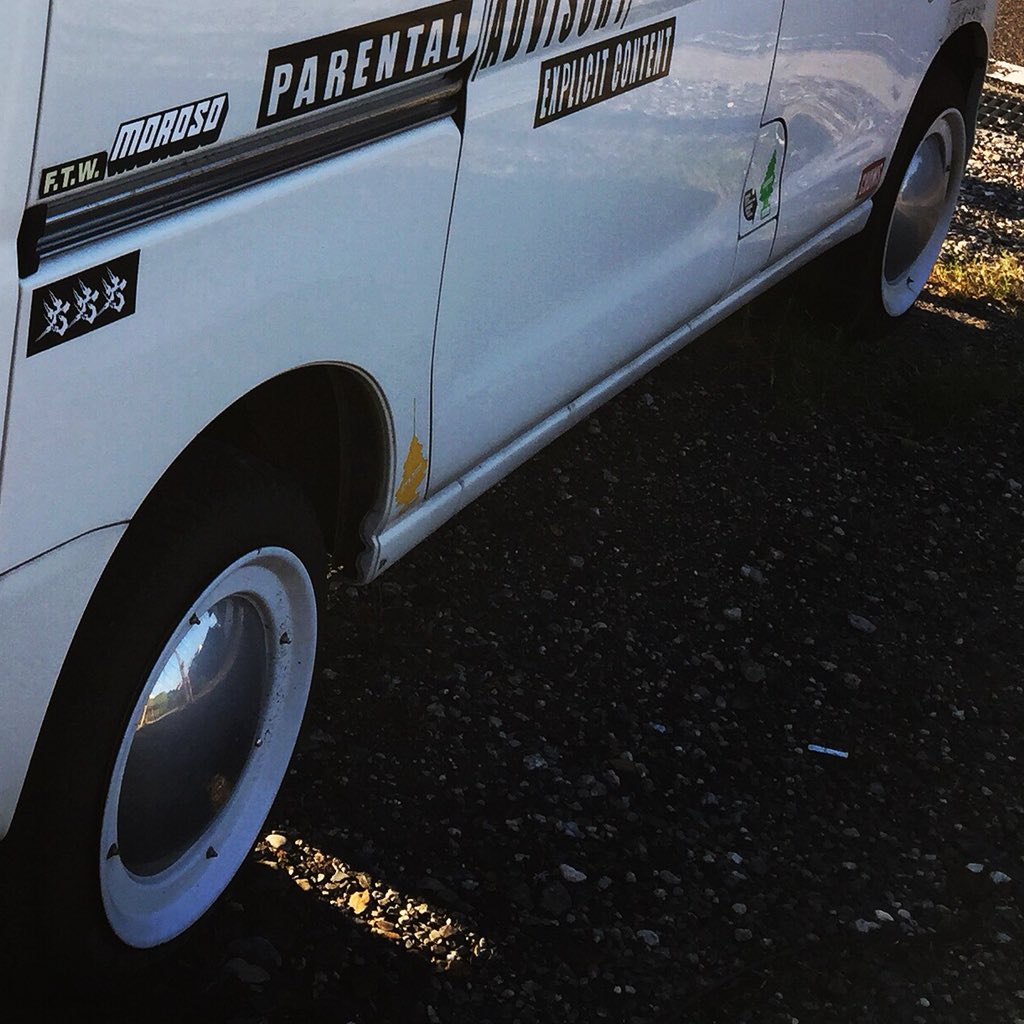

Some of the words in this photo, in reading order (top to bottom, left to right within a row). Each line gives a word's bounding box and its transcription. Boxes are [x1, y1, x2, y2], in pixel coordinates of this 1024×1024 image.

[267, 11, 466, 117] PARENTAL
[538, 49, 610, 120] EXPLICIT
[609, 26, 673, 93] CONTENT
[110, 94, 227, 163] MOROSO
